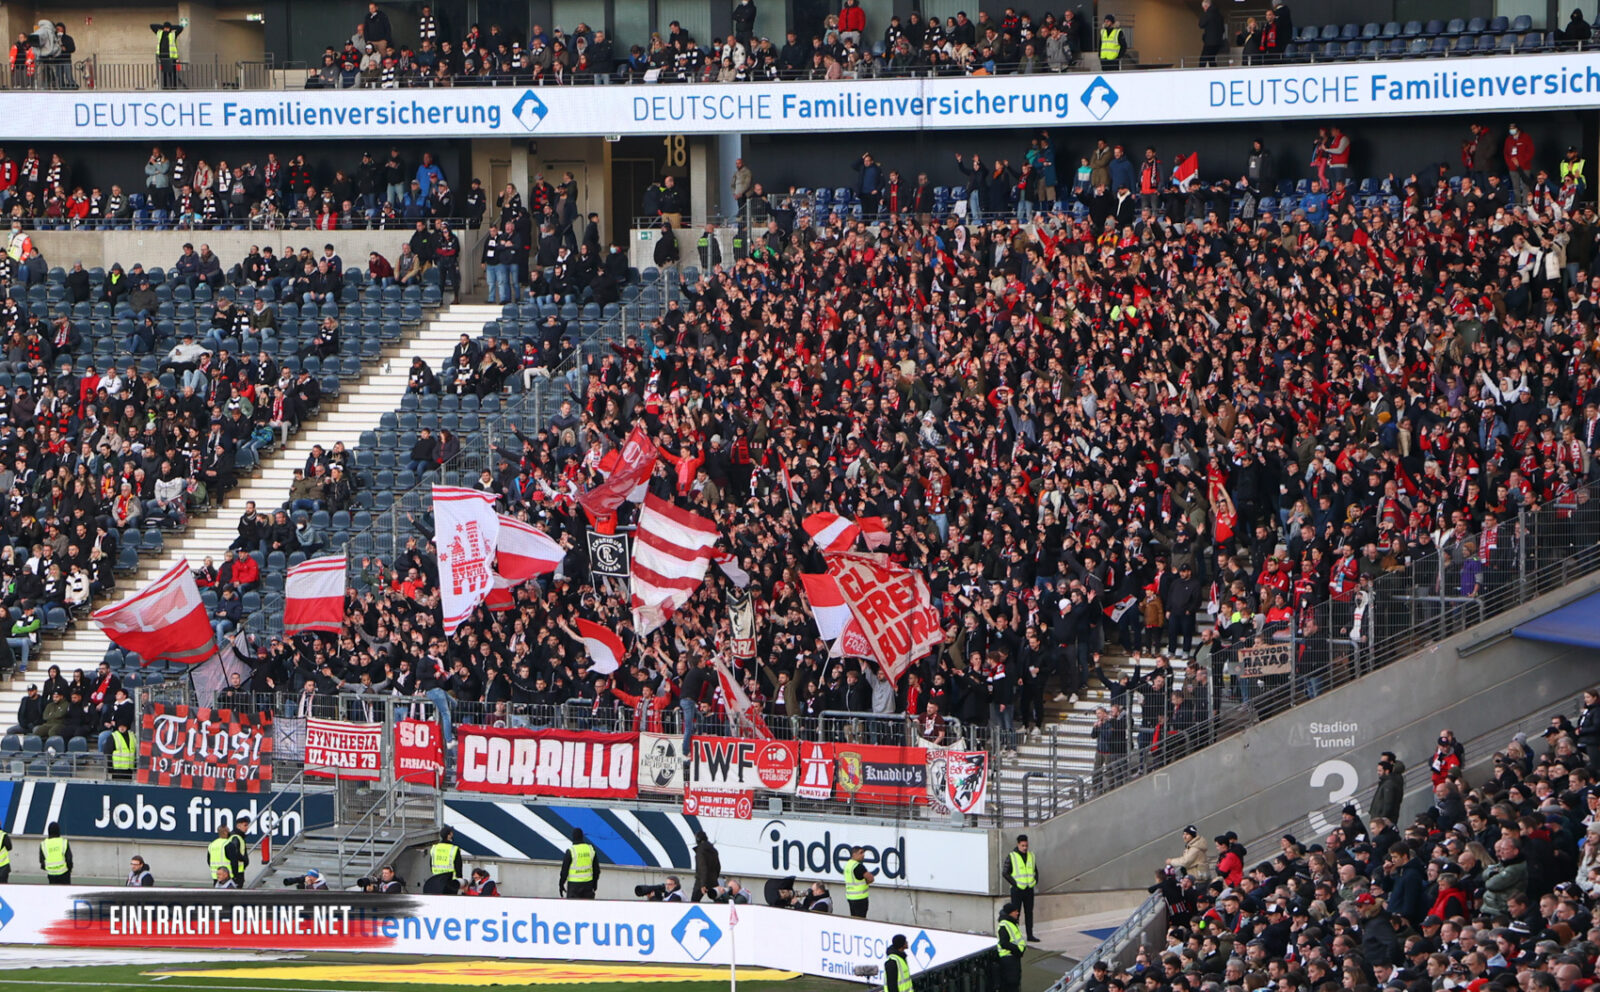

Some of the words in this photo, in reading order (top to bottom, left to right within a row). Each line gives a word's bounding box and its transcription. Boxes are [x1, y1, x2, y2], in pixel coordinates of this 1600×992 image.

[1210, 75, 1359, 108] DEUTSCHE
[1371, 65, 1600, 102] Familienversich
[74, 102, 213, 127] DEUTSCHE
[224, 98, 501, 129] Familienversicherung
[633, 94, 772, 122] DEUTSCHE
[782, 88, 1069, 120] Familienversicherung
[664, 135, 686, 167] 18
[154, 714, 263, 760] Tifosi
[307, 730, 379, 750] SYNTHESIA
[1310, 721, 1358, 734] Stadion
[1313, 736, 1355, 748] Tunnel
[152, 756, 168, 773] 19
[169, 758, 235, 782] Freiburg
[239, 764, 258, 780] 97
[308, 749, 357, 768] ULTRAS
[361, 753, 376, 768] 79
[463, 734, 634, 790] CORRILLO
[692, 739, 755, 782] IWF
[865, 765, 922, 784] Knaddly's
[95, 794, 177, 832] Jobs
[699, 805, 736, 818] SCHEISS
[1308, 760, 1362, 835] 3
[771, 830, 905, 880] indeed
